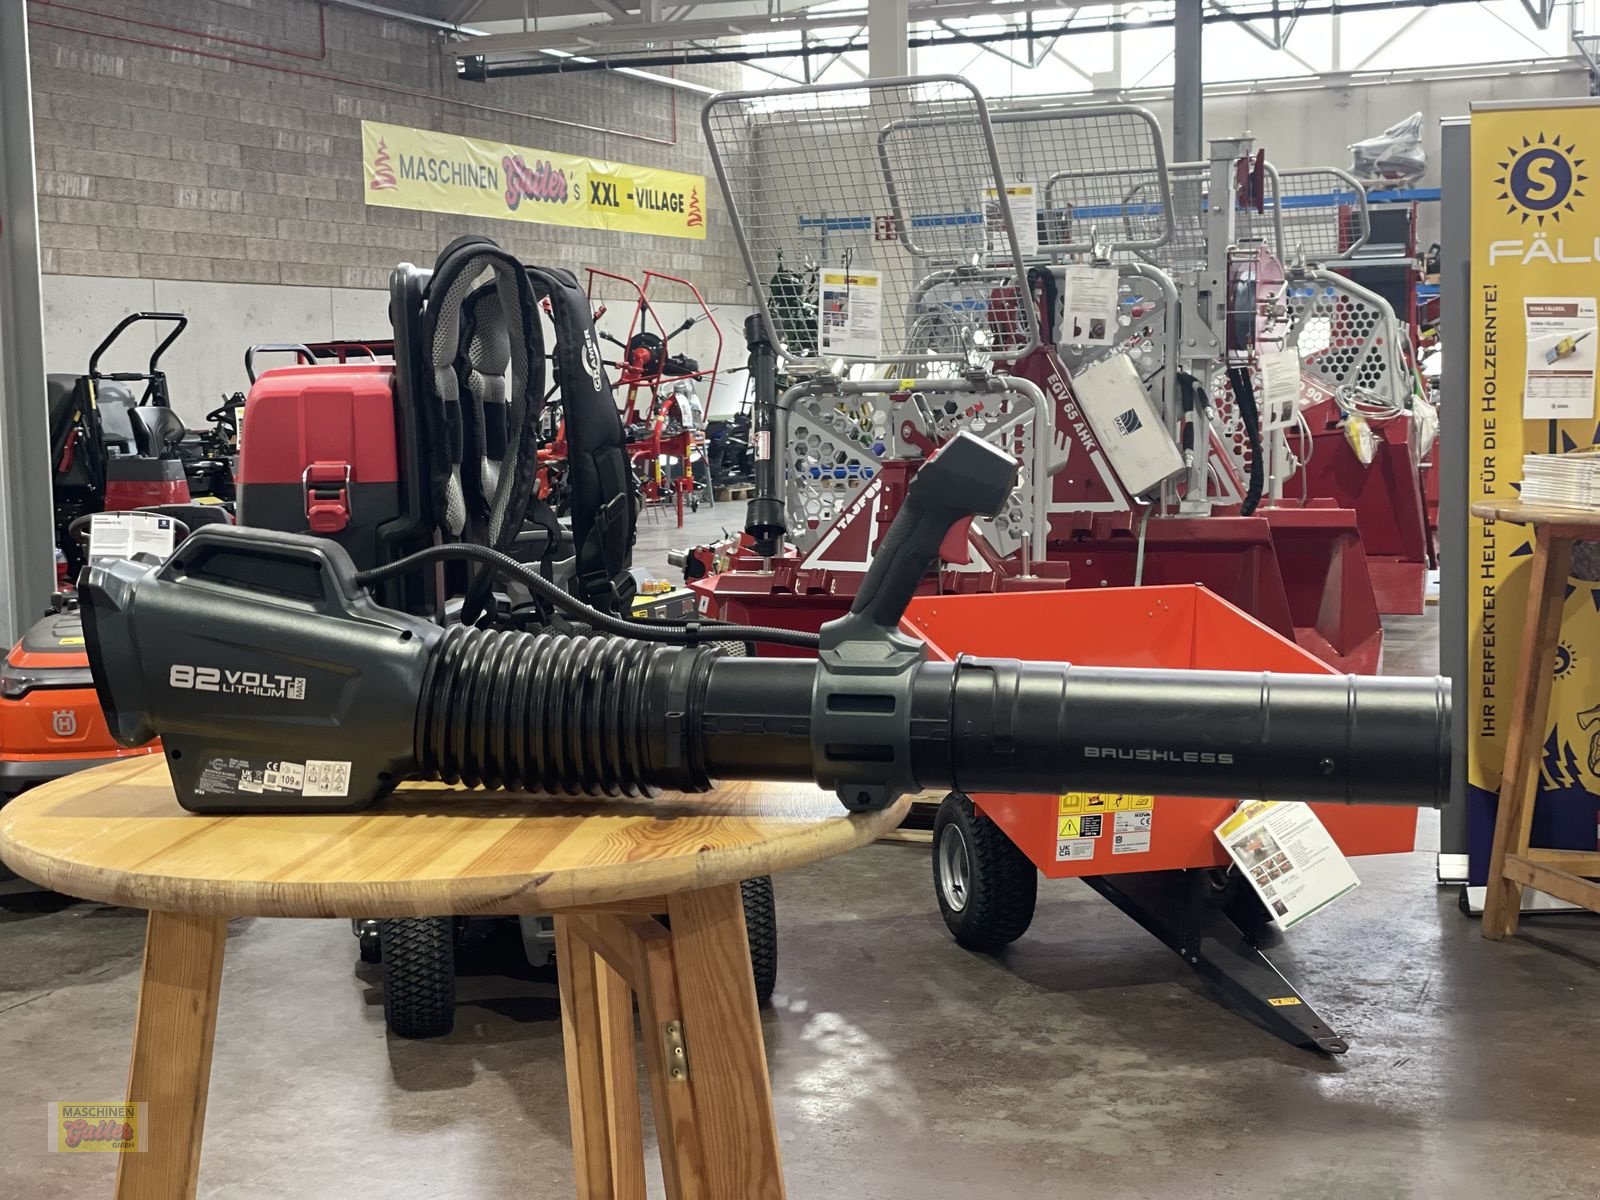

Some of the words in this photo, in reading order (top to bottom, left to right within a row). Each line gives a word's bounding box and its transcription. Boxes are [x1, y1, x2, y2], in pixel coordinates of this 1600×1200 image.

[400, 153, 498, 191] MASCHINEN
[590, 180, 620, 207] XXL
[636, 188, 685, 214] VILLAGE
[1525, 157, 1557, 201] S
[1489, 232, 1600, 266] FÄL
[1482, 284, 1498, 412] HOLZERNTE!
[1306, 387, 1323, 402] 90
[1047, 373, 1069, 401] EGV
[1063, 402, 1079, 421] 65
[1073, 423, 1096, 452] AHK
[1483, 418, 1496, 450] DIE
[1480, 456, 1496, 494] FÜR
[1481, 518, 1496, 578] HELFE
[1482, 585, 1496, 698] PERFEKTER
[170, 664, 221, 692] 82
[224, 670, 293, 690] VOLT
[222, 683, 285, 698] LITHIUM
[295, 678, 306, 699] MAX
[1481, 704, 1496, 737] IHR
[1084, 746, 1234, 764] BRUSHLESS
[281, 775, 295, 785] 109
